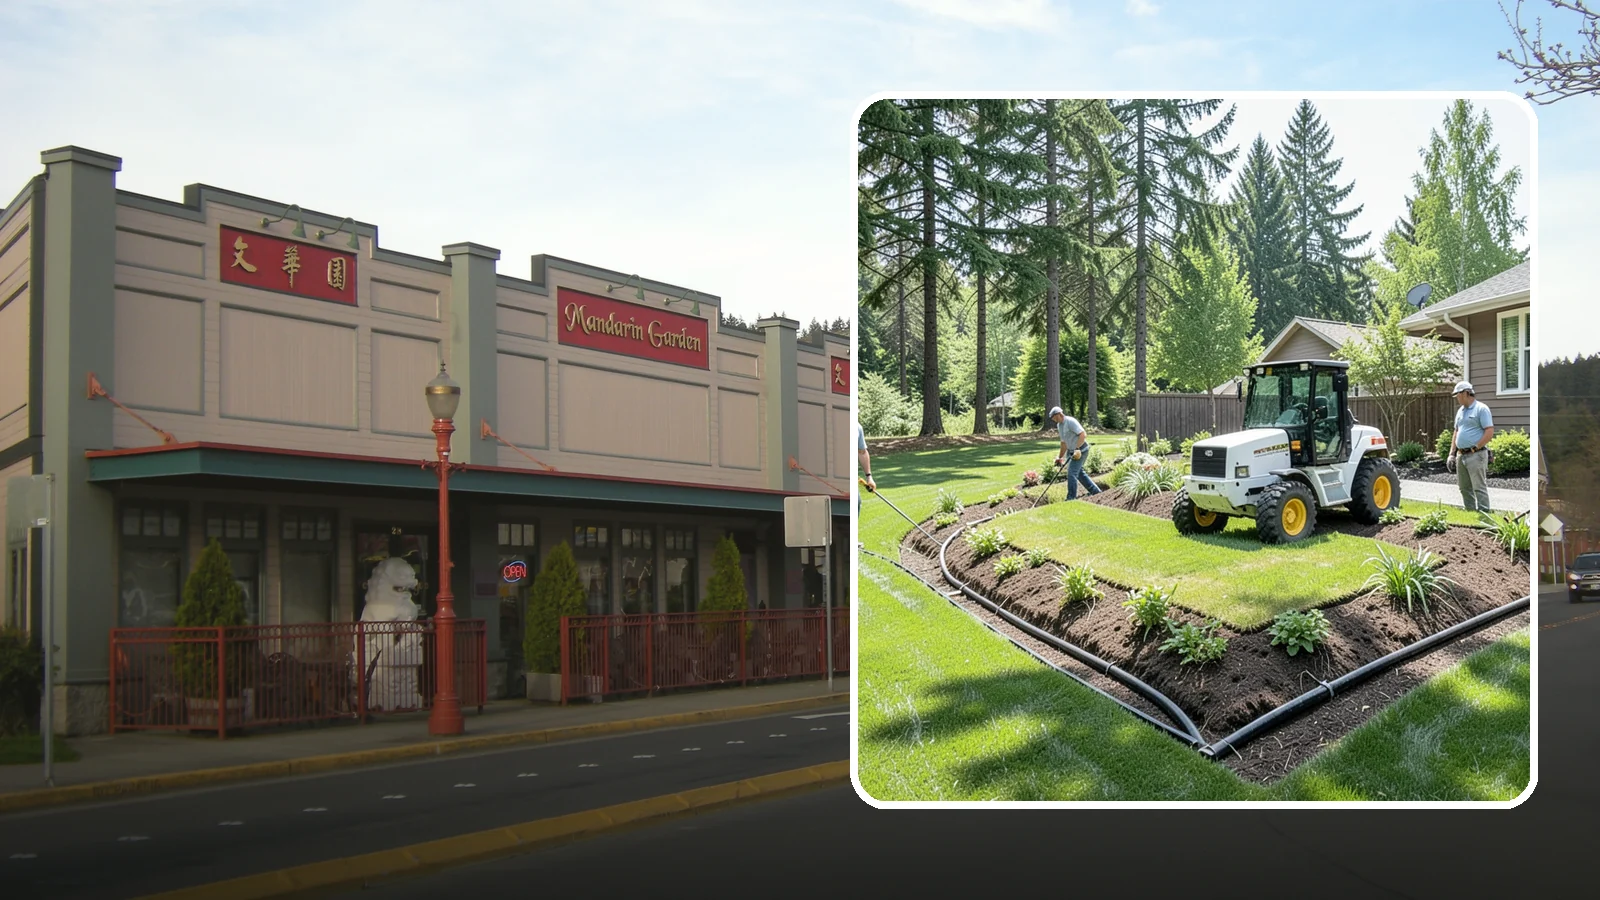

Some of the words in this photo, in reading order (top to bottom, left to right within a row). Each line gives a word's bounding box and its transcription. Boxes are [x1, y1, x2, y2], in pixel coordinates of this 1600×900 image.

[564, 302, 644, 341] Mandarin
[648, 320, 701, 352] Garden
[503, 565, 527, 578] OPEN
